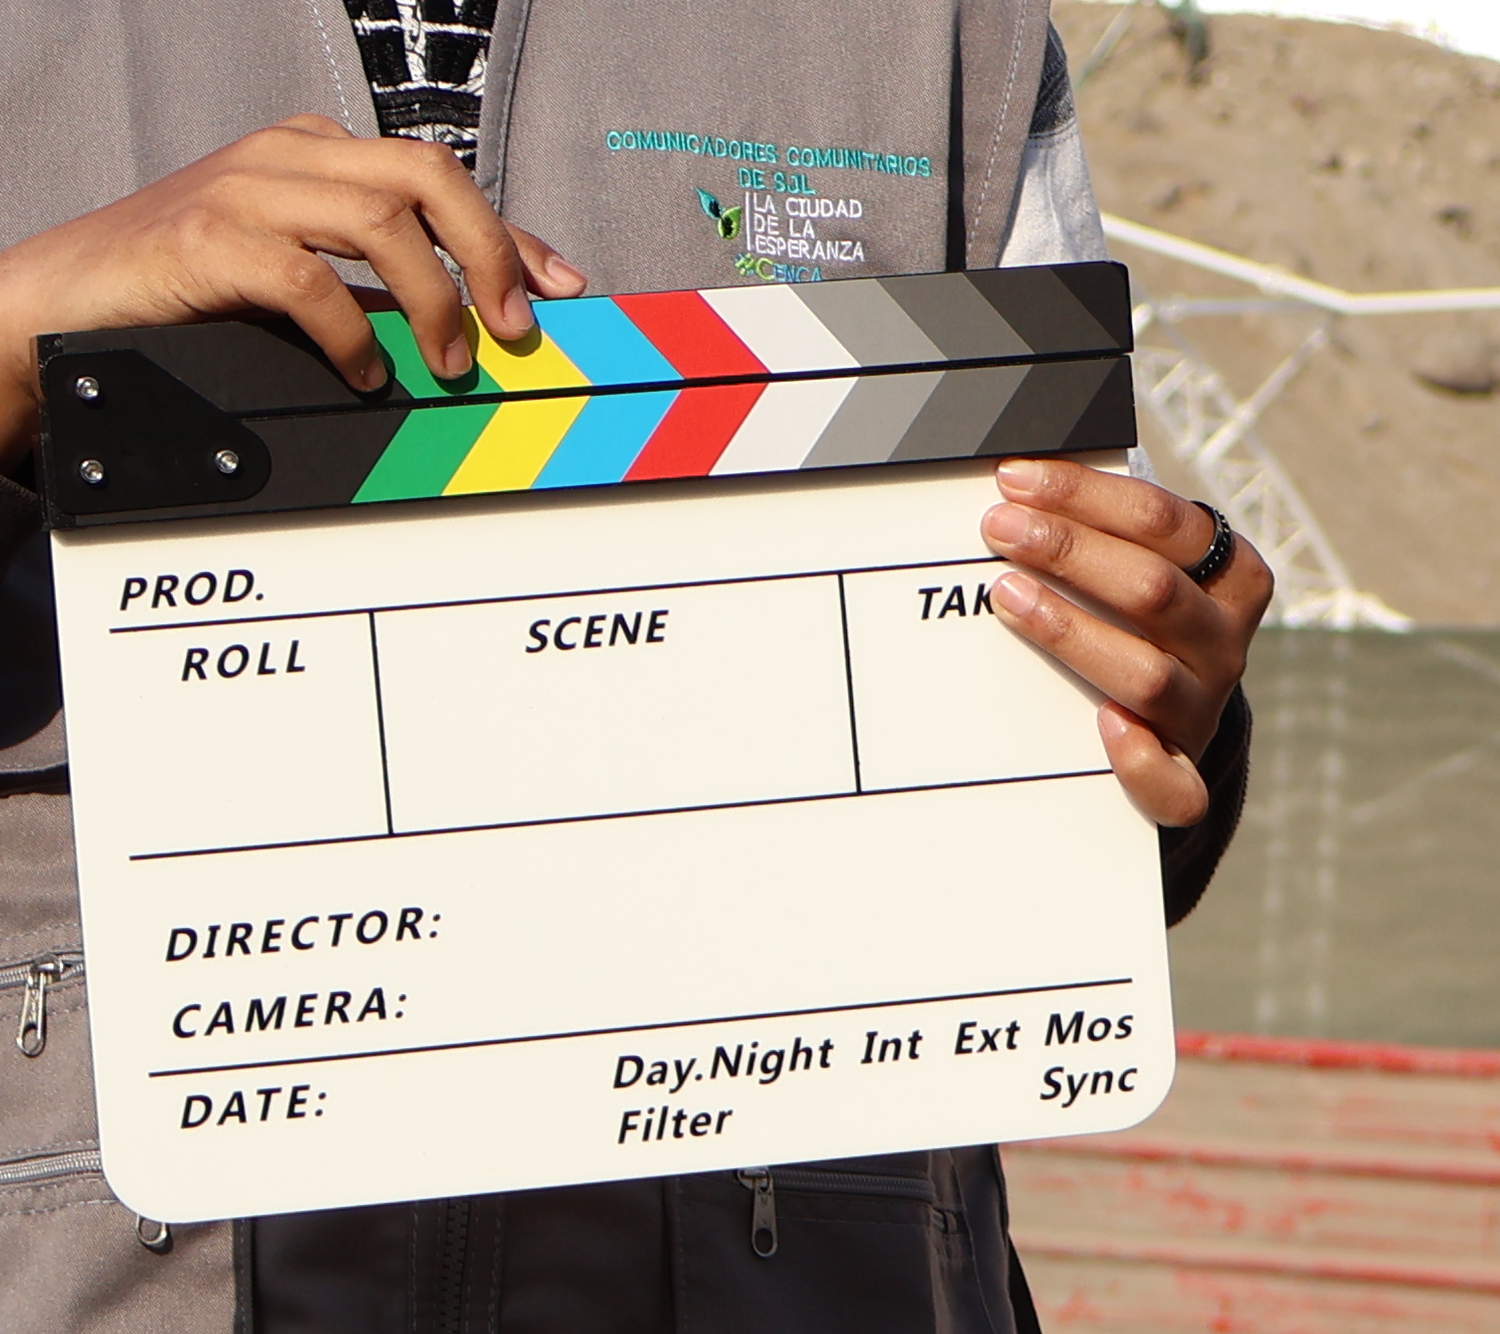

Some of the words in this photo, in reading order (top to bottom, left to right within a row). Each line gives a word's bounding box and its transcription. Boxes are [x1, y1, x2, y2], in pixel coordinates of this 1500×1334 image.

[606, 130, 778, 163] COMUNICADORES
[786, 146, 933, 177] COMUNITARIOS
[739, 168, 768, 190] DE
[773, 172, 817, 195] SJL
[753, 192, 777, 214] LA
[785, 197, 863, 218] CIUDAD
[754, 213, 780, 235] DE
[789, 219, 815, 239] LA
[755, 236, 865, 262] ESPERANZA
[120, 569, 264, 611] PROD.
[917, 582, 996, 621] TAK
[525, 609, 669, 654] SCENE
[181, 640, 306, 682] ROLL
[165, 907, 441, 962] DIRECTOR:
[172, 987, 407, 1039] CAMERA:
[860, 1030, 923, 1065] Int
[954, 1020, 1021, 1055] Ext
[1044, 1011, 1133, 1046] Mos
[180, 1084, 327, 1129] DATE:
[1040, 1066, 1138, 1109] Sync
[618, 1105, 733, 1145] Filter
